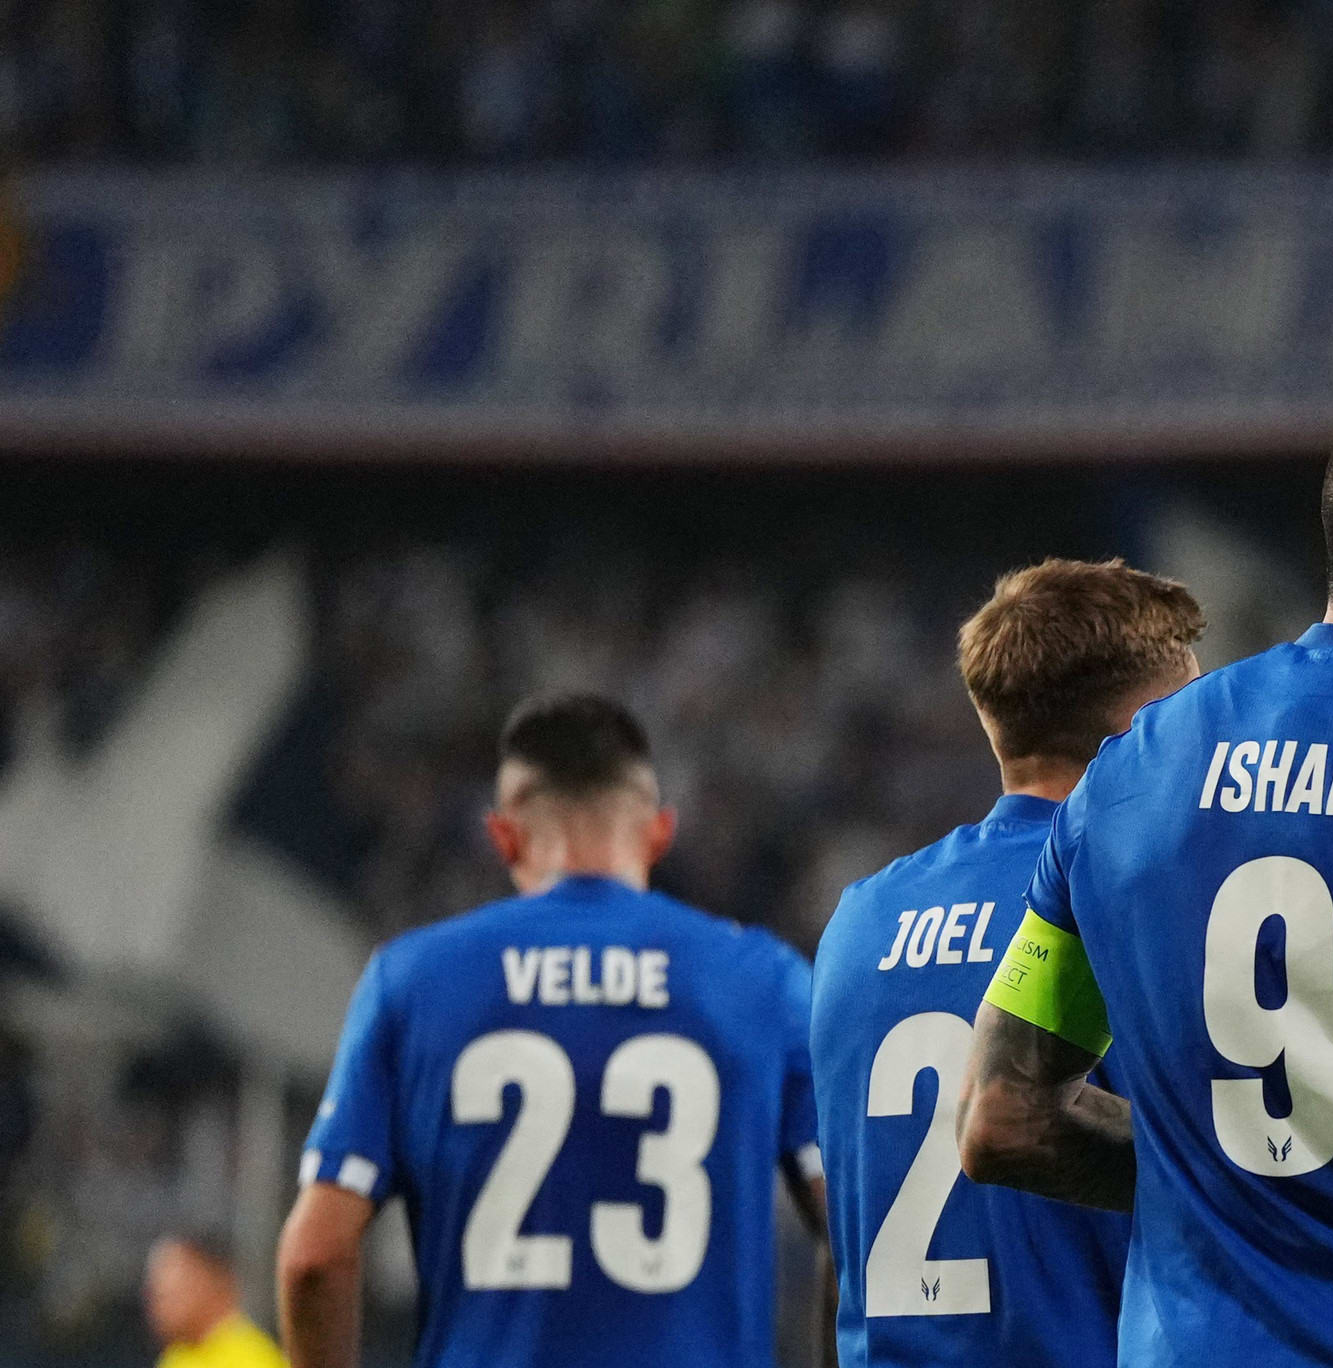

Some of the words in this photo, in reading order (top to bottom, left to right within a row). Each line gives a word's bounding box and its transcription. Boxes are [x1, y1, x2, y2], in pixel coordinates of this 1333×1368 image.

[502, 947, 669, 1008] VELDE
[878, 902, 995, 971] JOEL
[451, 1028, 720, 1294] 23
[866, 1011, 991, 1317] 2
